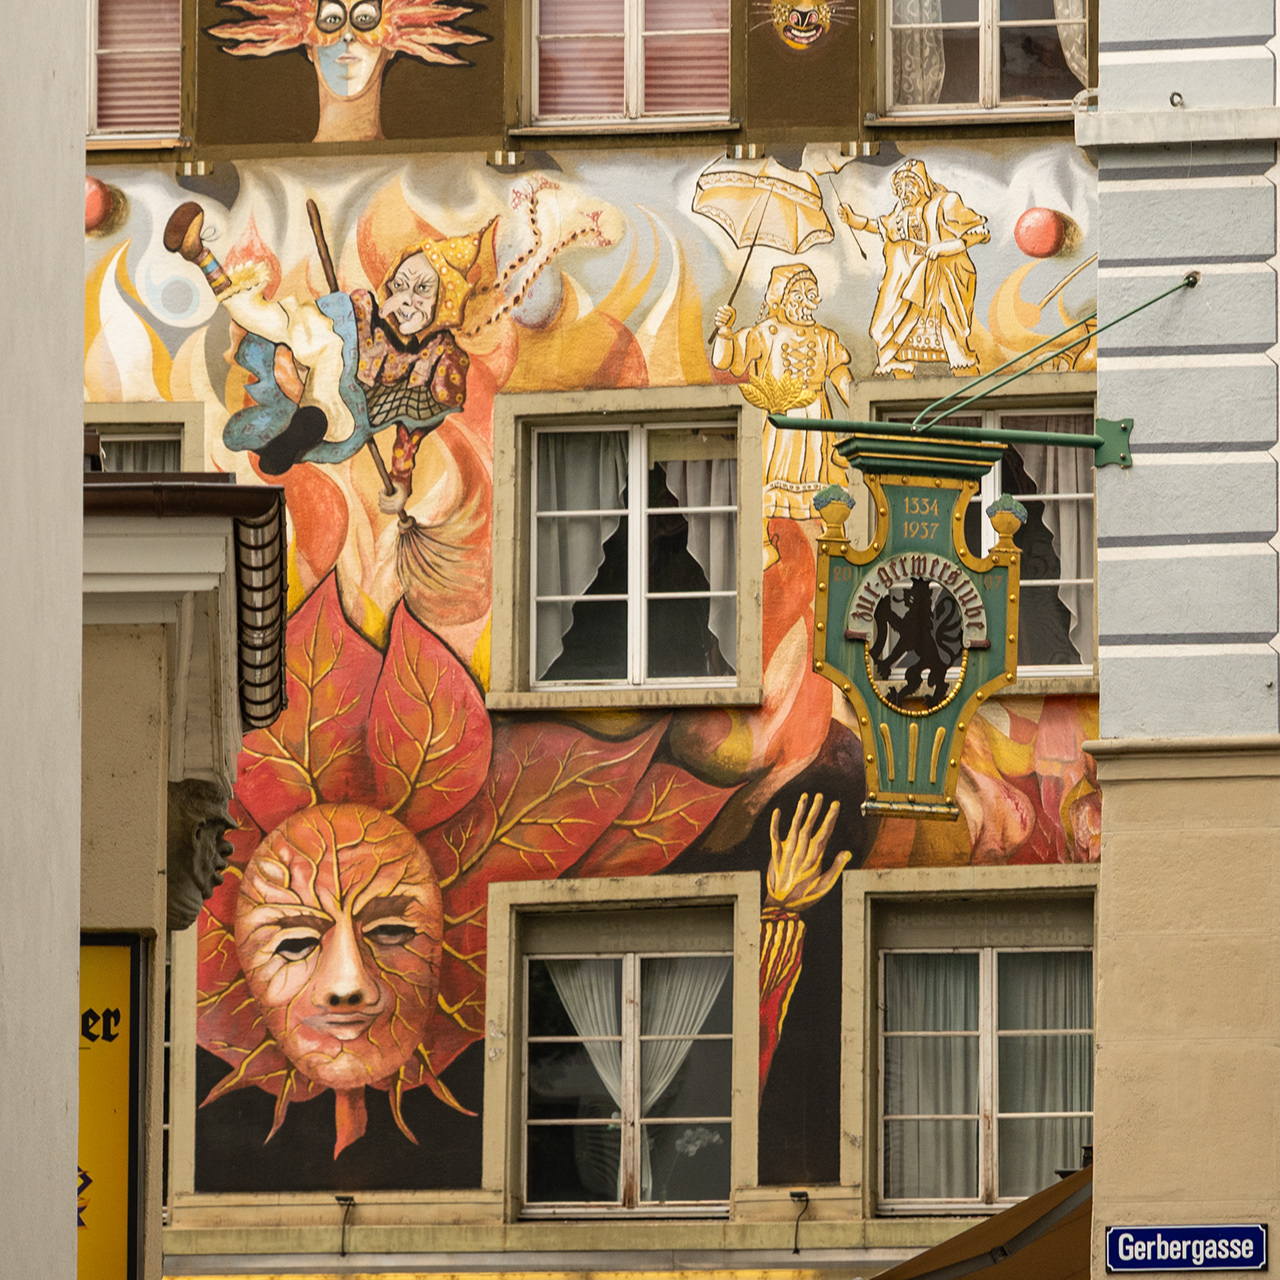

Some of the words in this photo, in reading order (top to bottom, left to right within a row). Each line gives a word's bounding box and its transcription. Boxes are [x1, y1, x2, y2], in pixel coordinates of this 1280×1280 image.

[903, 496, 939, 516] 1334
[903, 522, 940, 540] 1937
[833, 566, 852, 582] 20
[984, 574, 1003, 591] 07
[81, 1007, 121, 1043] er
[1118, 1233, 1254, 1265] Gerbergasse
